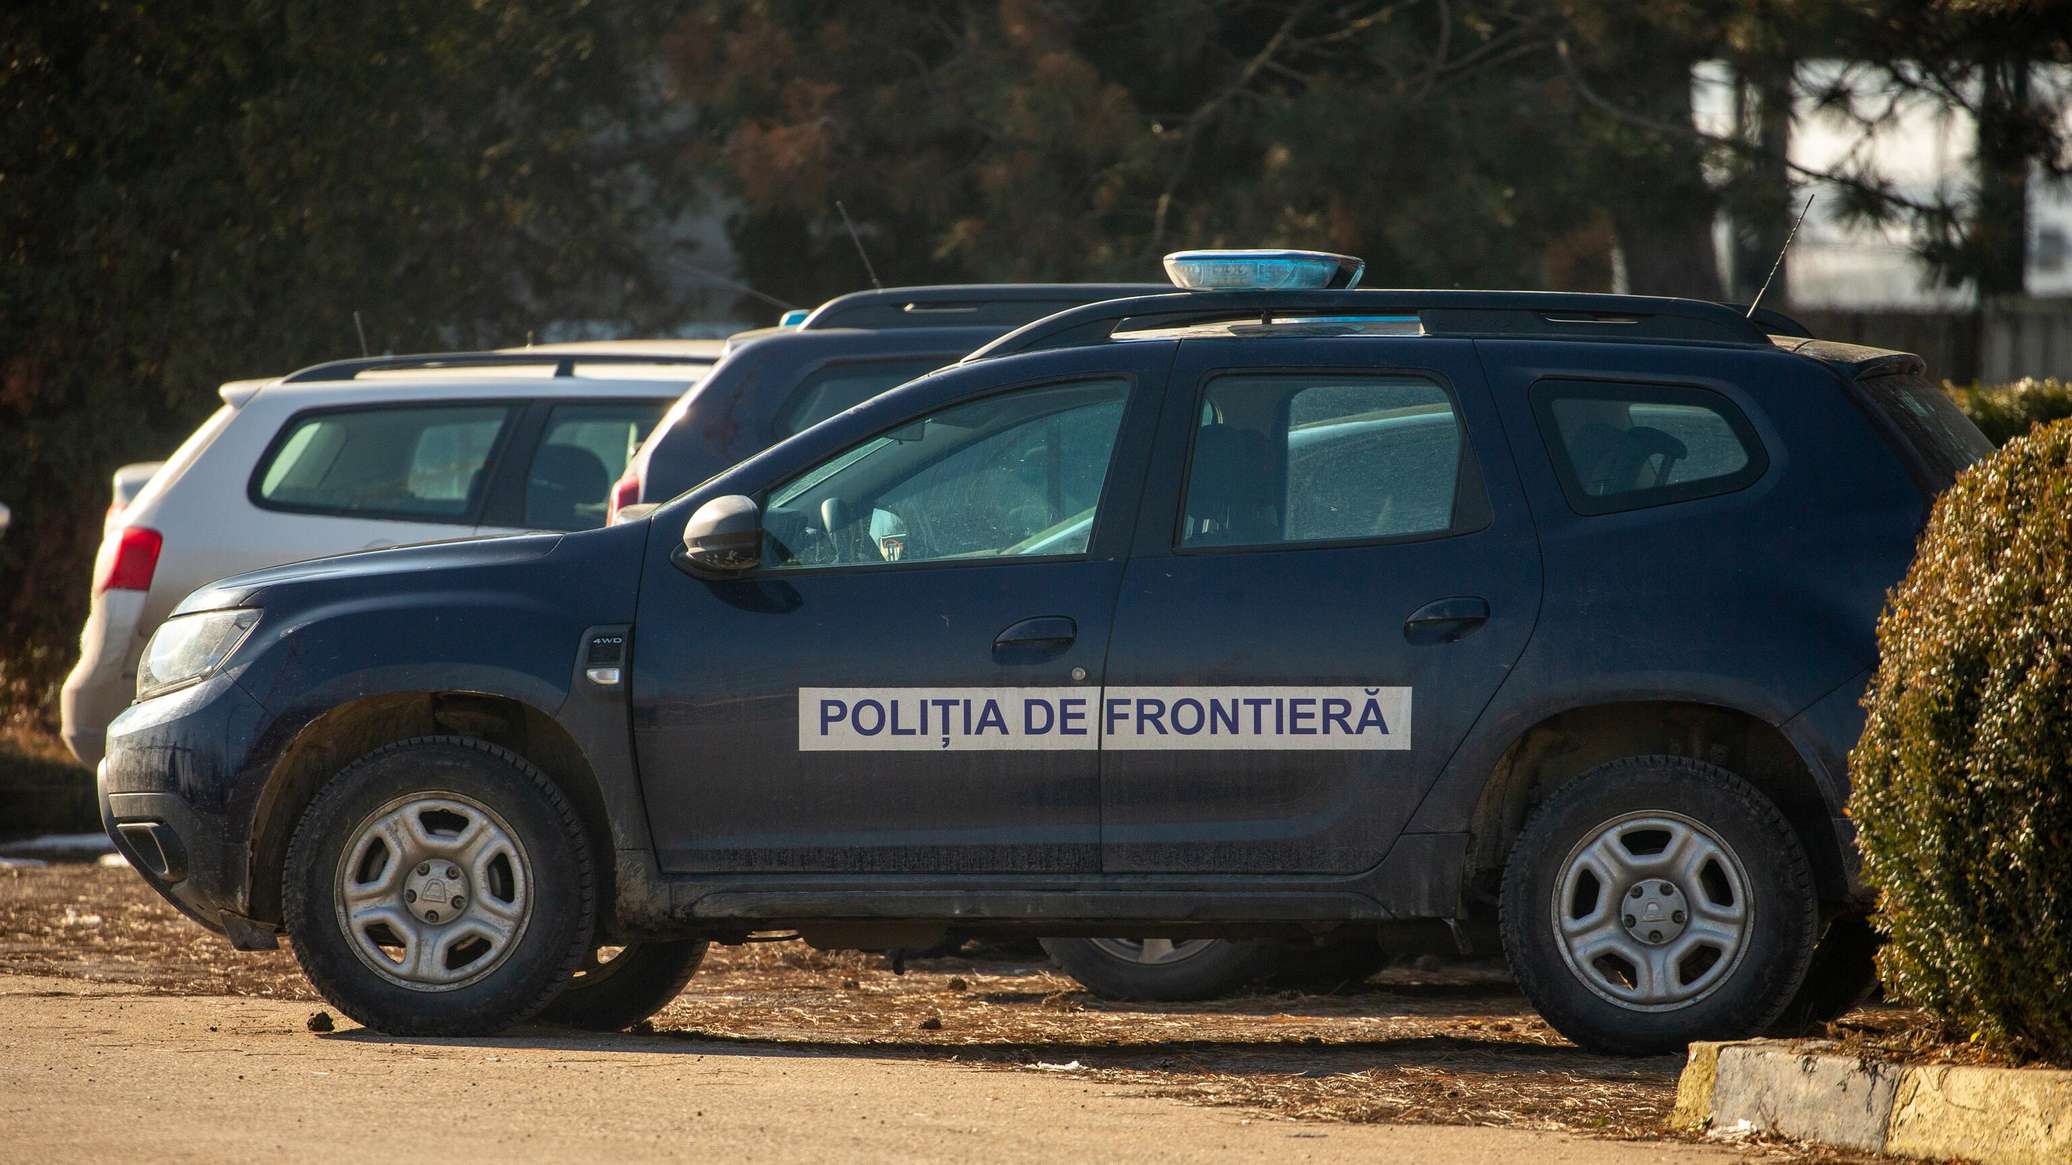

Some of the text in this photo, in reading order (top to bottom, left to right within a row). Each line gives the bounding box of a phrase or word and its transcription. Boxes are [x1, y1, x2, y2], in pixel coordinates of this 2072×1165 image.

[820, 688, 1389, 748] POLIȚIA DE FRONTIERĂ
